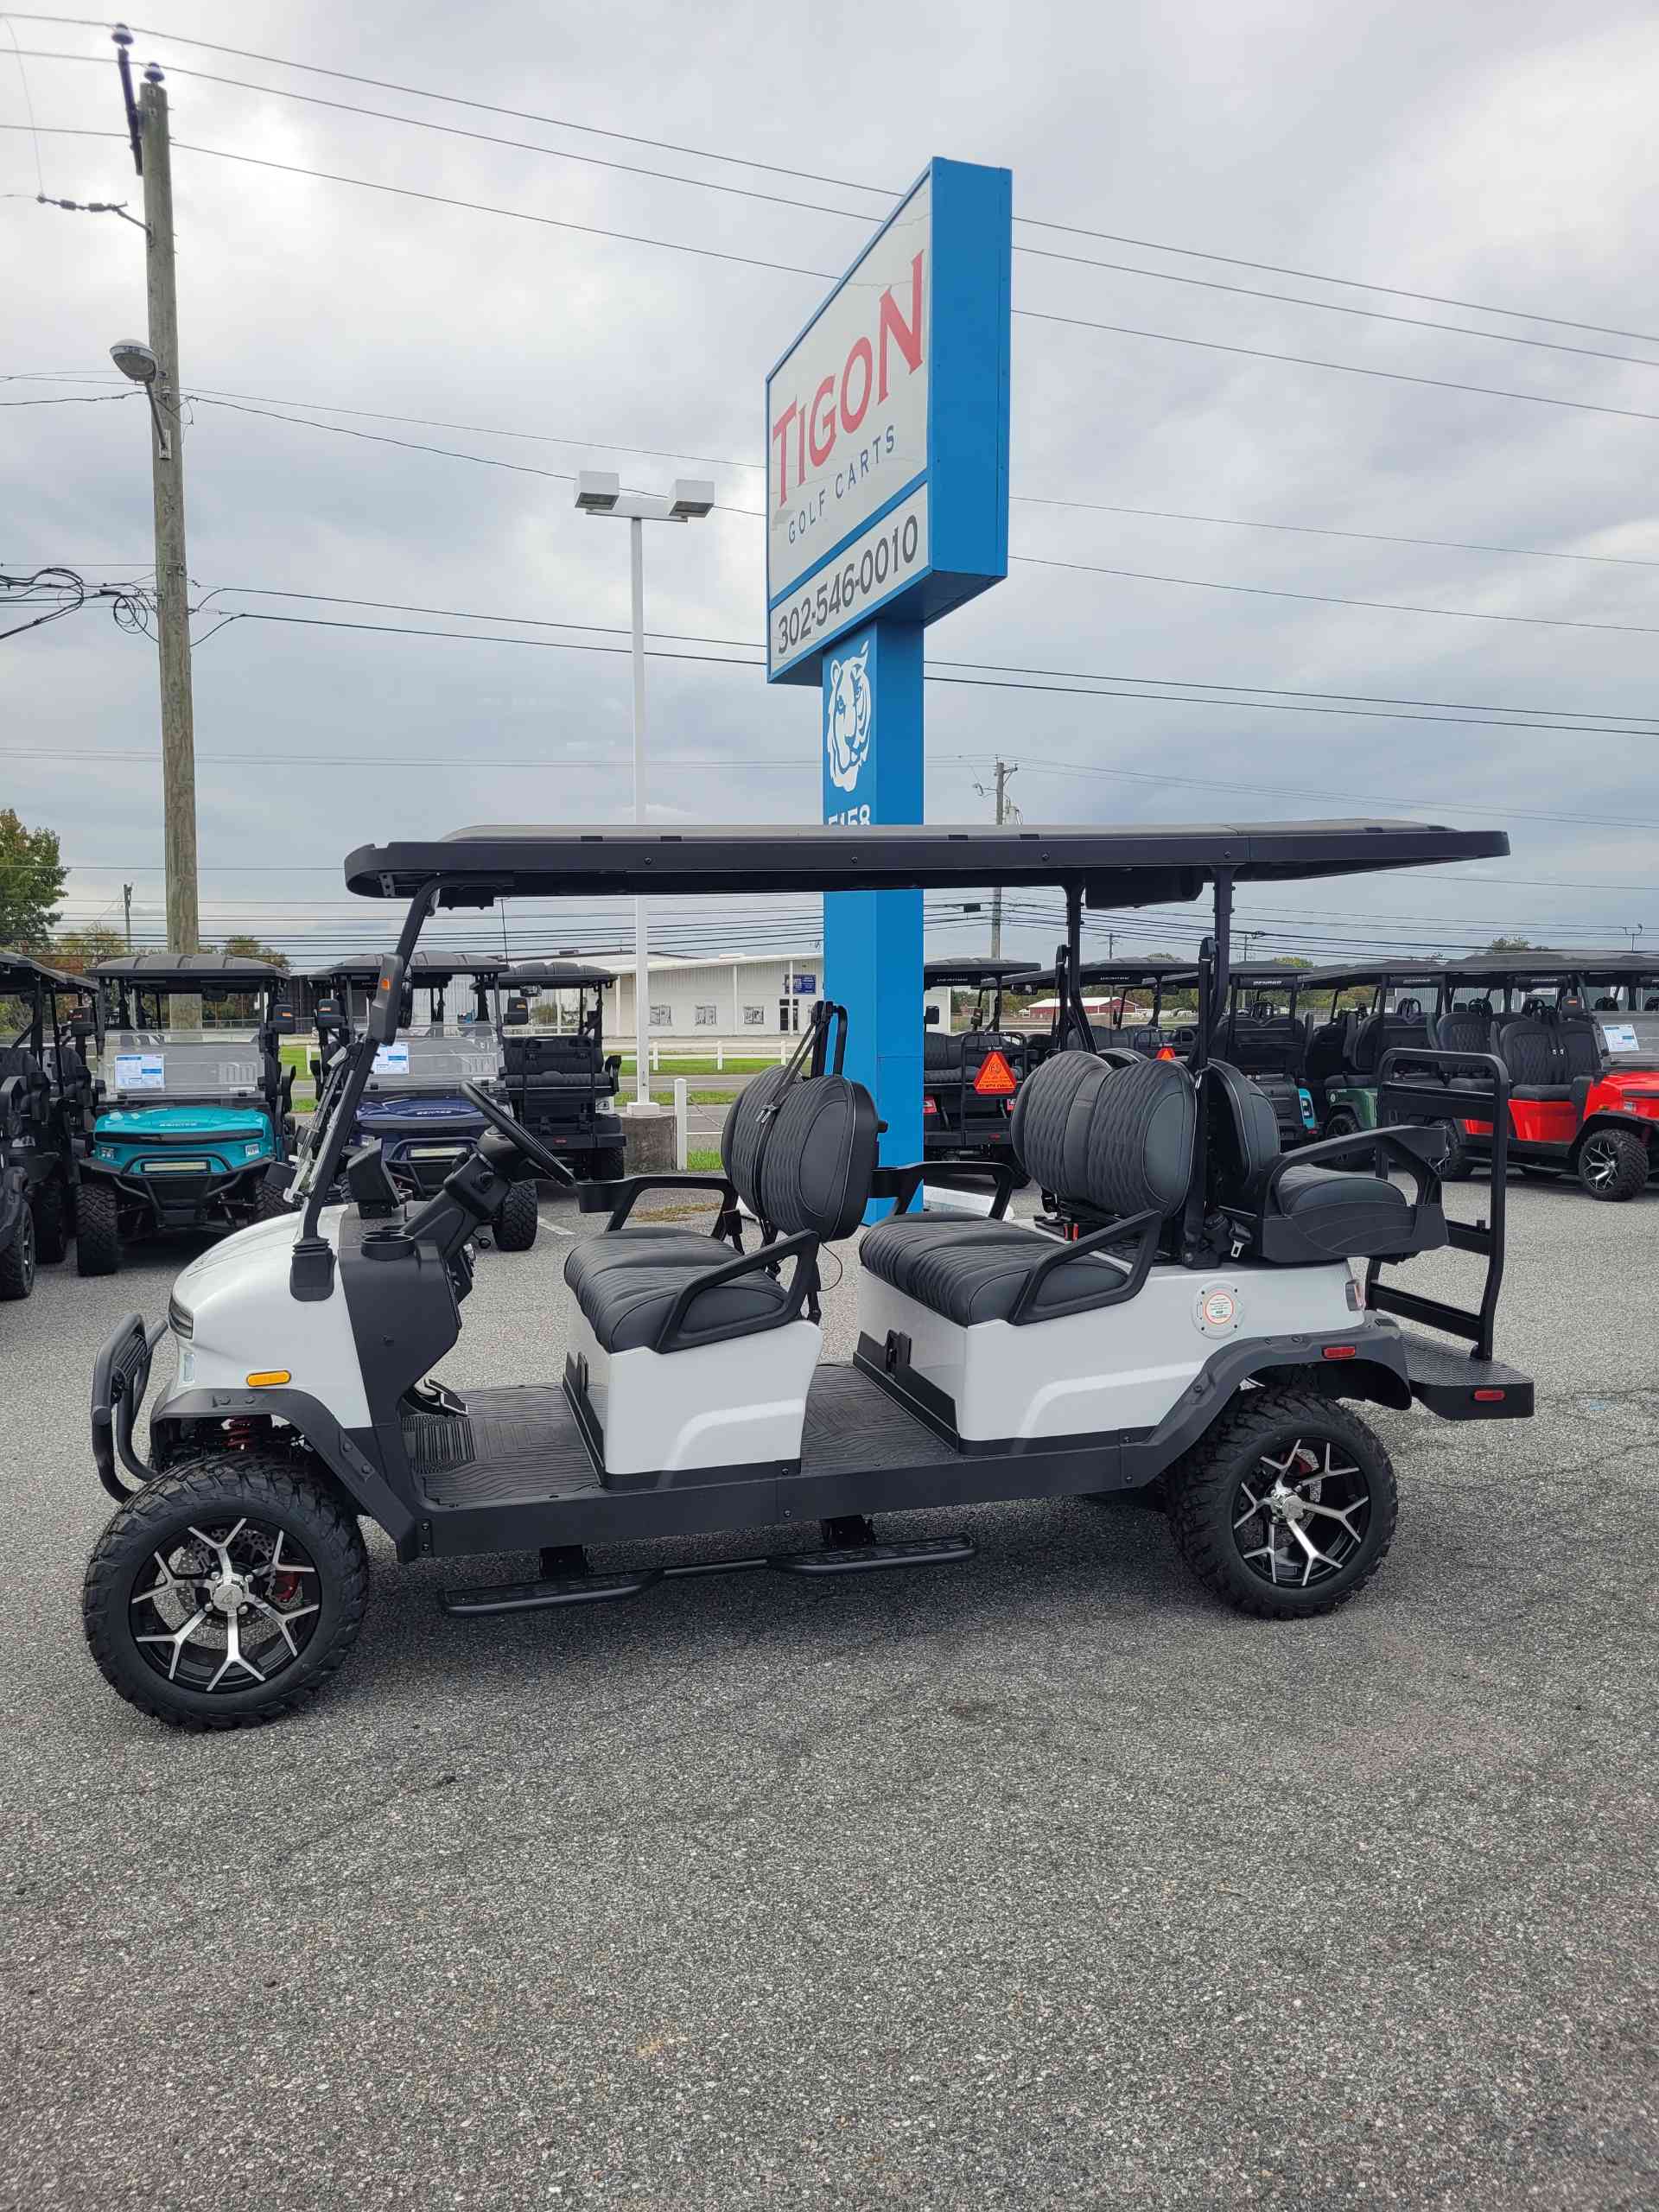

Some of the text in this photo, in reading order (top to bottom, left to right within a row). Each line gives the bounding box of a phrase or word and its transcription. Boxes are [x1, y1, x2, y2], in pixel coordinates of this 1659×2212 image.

[772, 249, 924, 507] TIGON
[788, 424, 894, 544] GOLF CARTS
[778, 514, 918, 654] 302-546-0010
